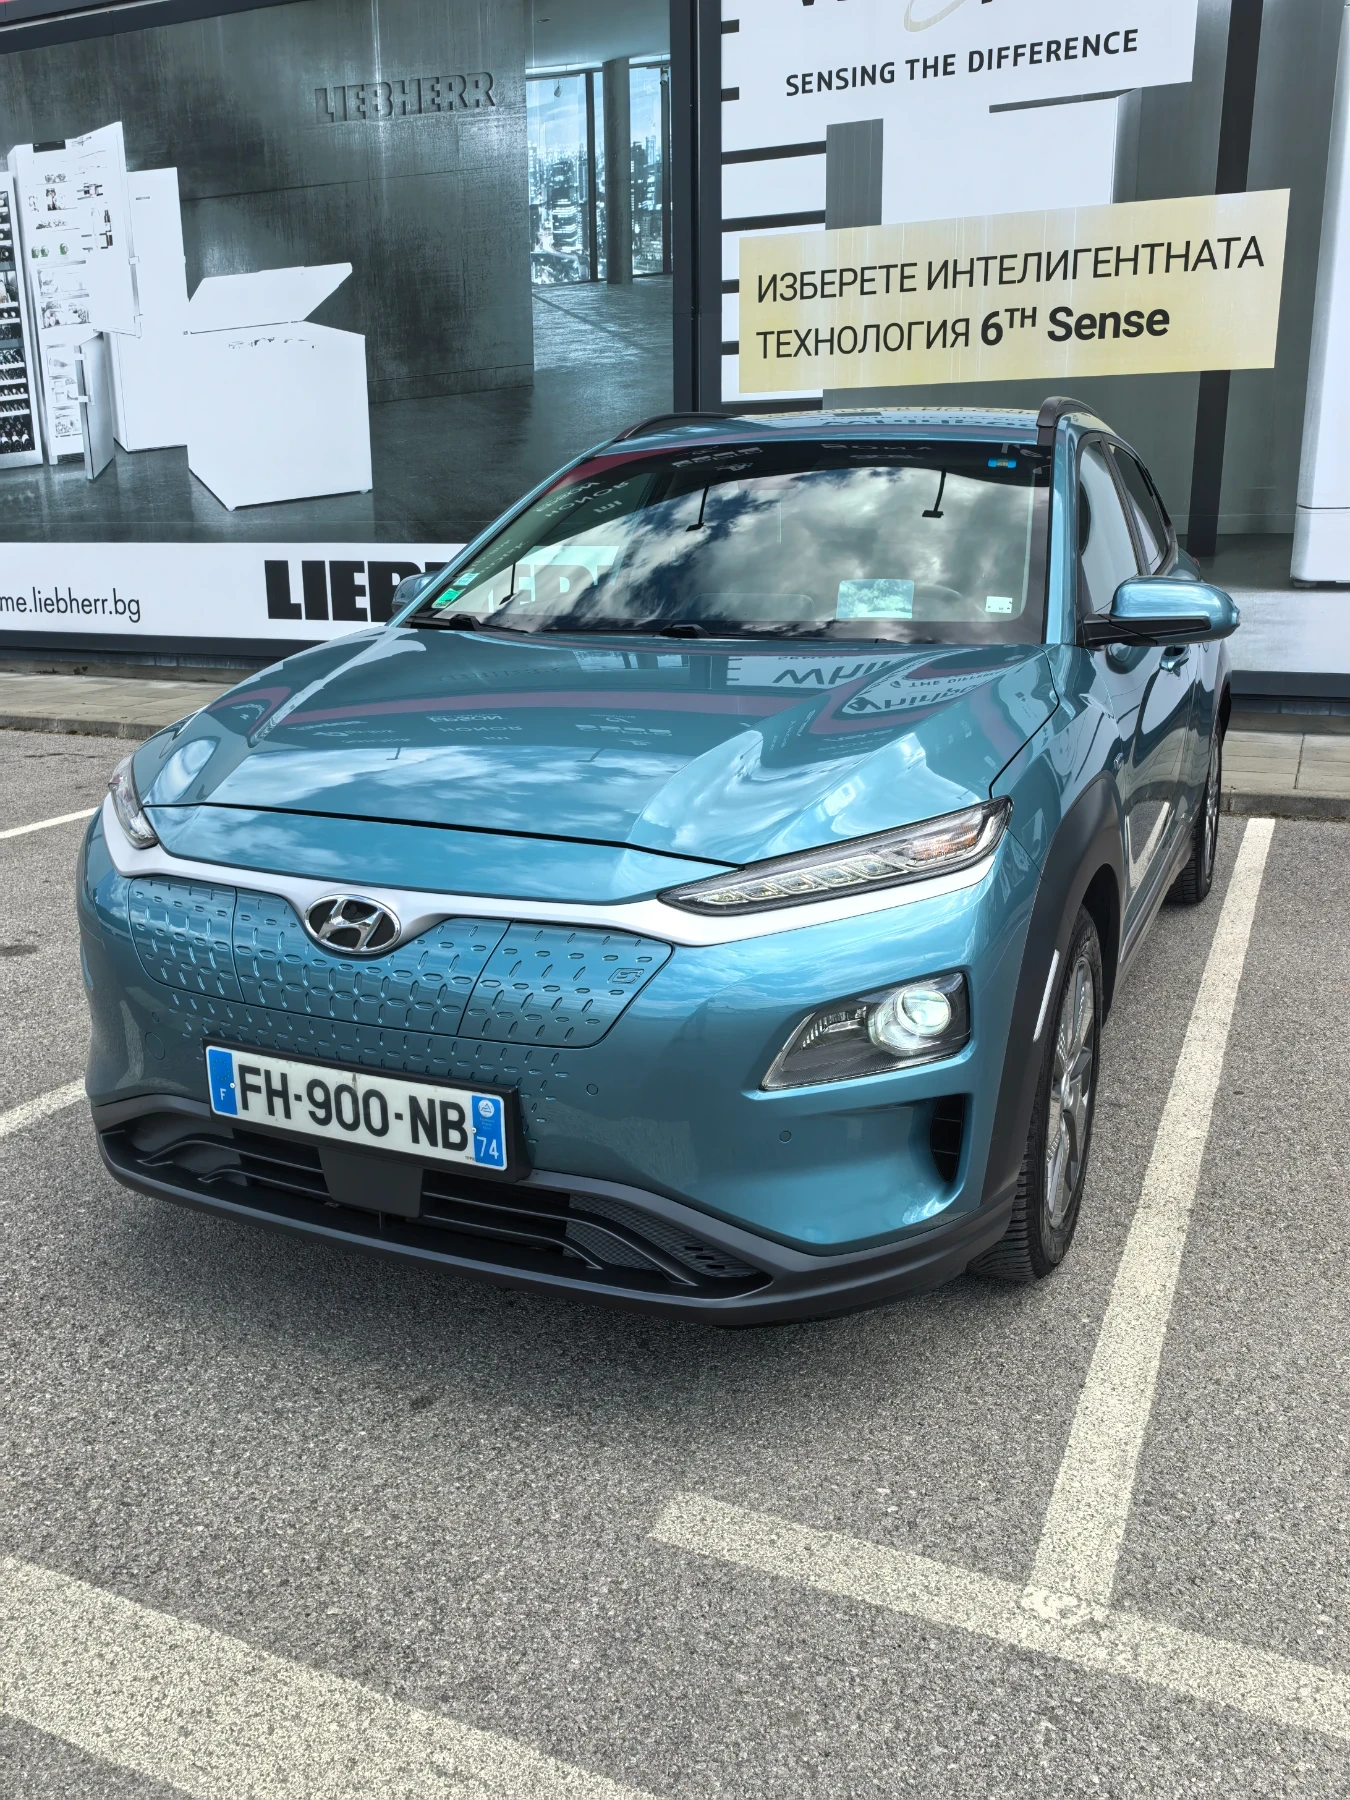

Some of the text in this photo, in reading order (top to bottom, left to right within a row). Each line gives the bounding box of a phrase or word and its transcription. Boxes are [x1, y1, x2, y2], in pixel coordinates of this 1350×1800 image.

[786, 29, 1138, 96] SENSING THE DIFFERENCE
[315, 72, 496, 123] LIEBHERR
[757, 235, 1265, 303] ИЗБЕРЕТЕ ИНТЕЛИГЕНТНАТА
[756, 311, 970, 359] ТЕХНОЛОГИЯ
[1047, 307, 1170, 342] Sense
[0, 586, 141, 623] me.liebherr.bg
[218, 1063, 469, 1152] F FH-900-NB
[476, 1135, 499, 1160] 74
